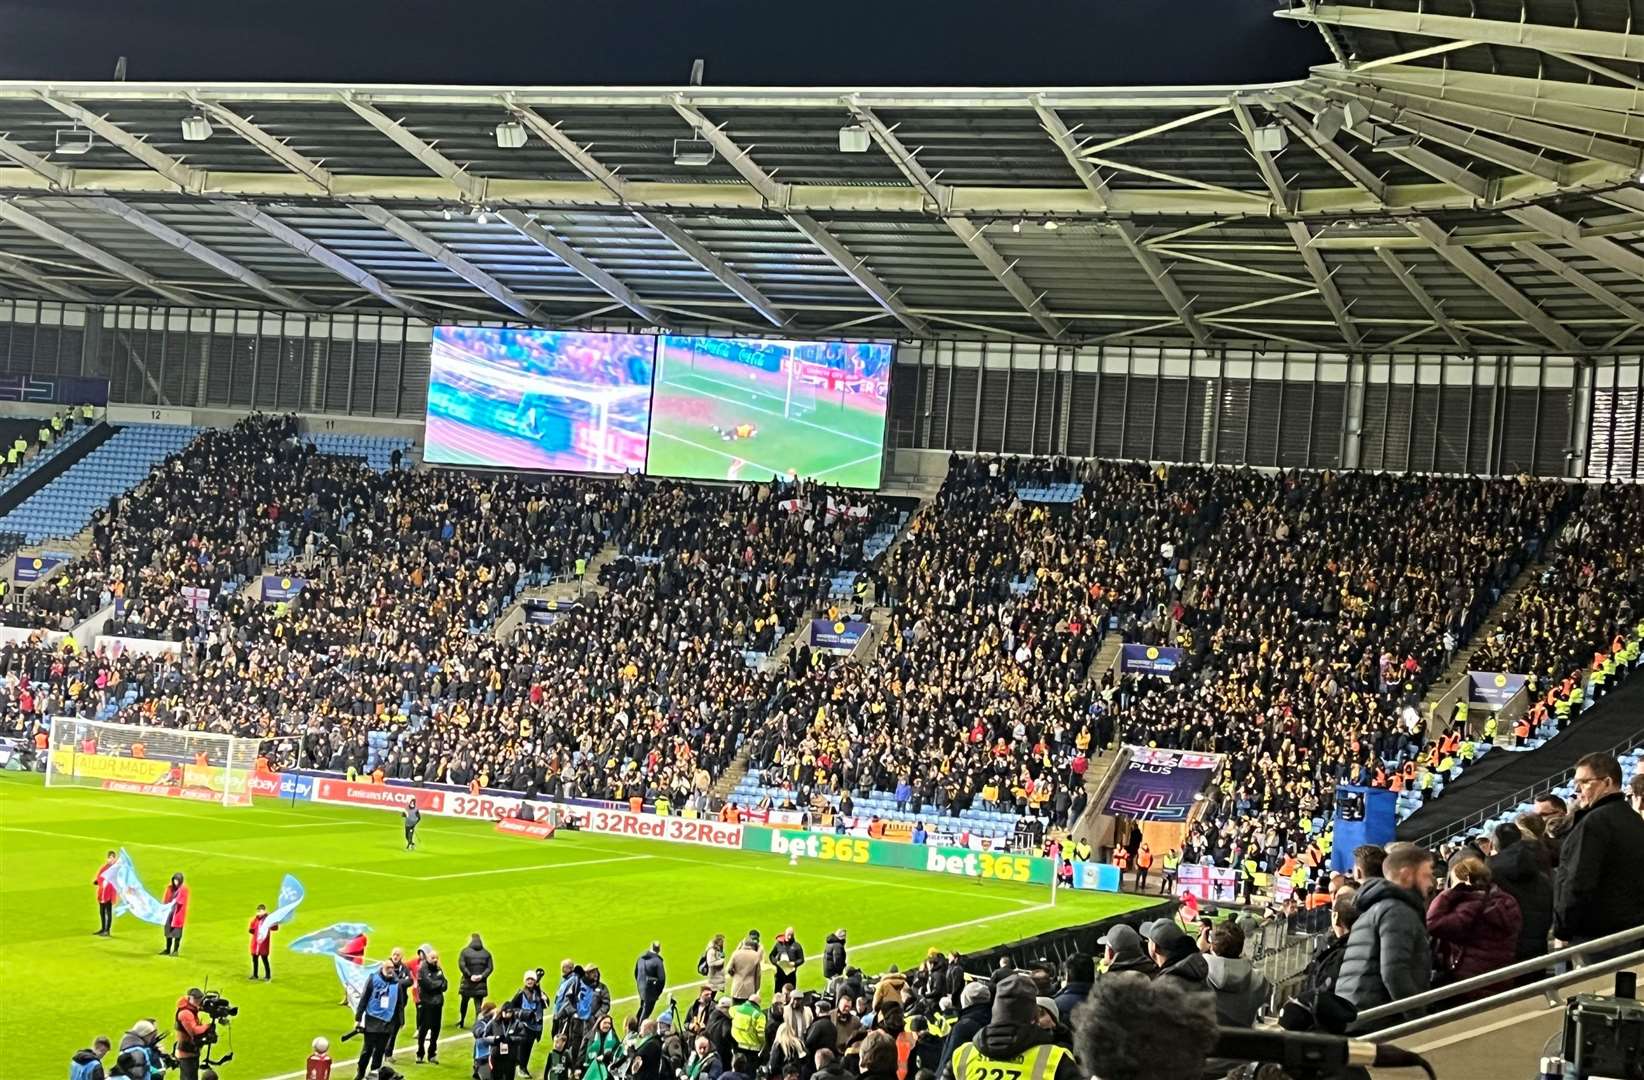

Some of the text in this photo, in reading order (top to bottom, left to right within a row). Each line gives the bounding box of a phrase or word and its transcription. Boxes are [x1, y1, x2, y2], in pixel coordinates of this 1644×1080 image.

[152, 410, 161, 420] 12
[326, 420, 335, 430] 11
[75, 755, 116, 771] AILOR
[119, 759, 156, 776] MADE
[1129, 762, 1172, 775] PLUS
[248, 775, 278, 793] ebay
[280, 778, 312, 796] ebay
[382, 791, 394, 802] FA
[453, 796, 521, 820] 32Red
[595, 811, 666, 838] 32Red
[669, 820, 741, 847] 32Red
[771, 829, 870, 864] bet365
[926, 846, 1030, 882] bet365
